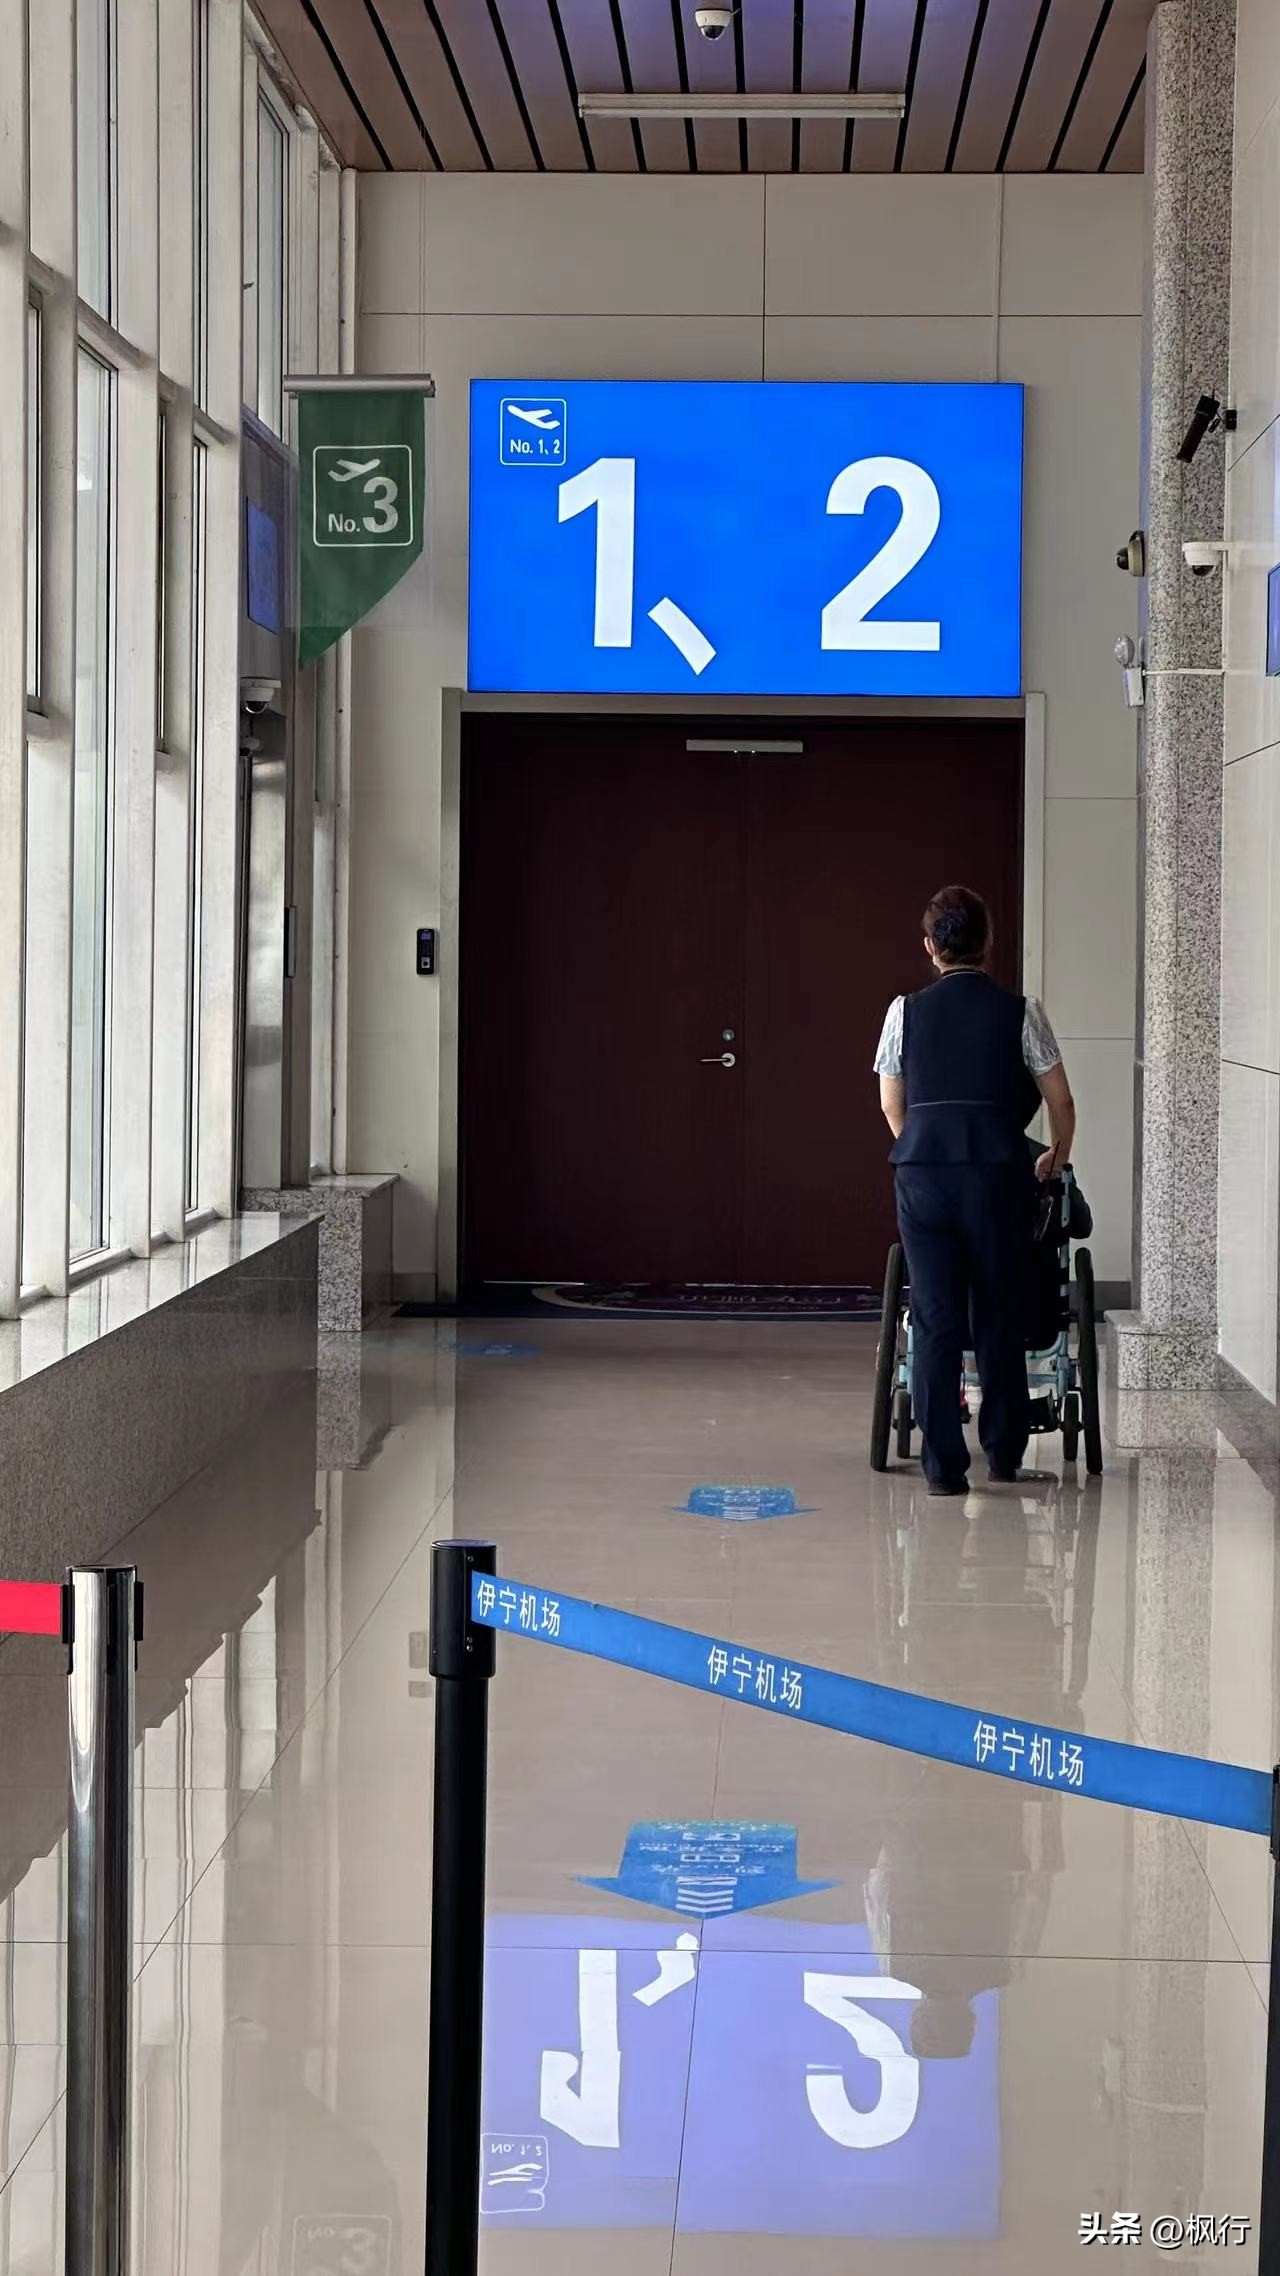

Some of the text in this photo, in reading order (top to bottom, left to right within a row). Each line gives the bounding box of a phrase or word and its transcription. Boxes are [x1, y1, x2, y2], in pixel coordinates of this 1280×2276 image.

[510, 438, 533, 454] No.
[477, 1579, 561, 1637] 伊宁机场
[707, 1644, 803, 1710] 伊宁机场
[973, 1719, 1085, 1787] 伊宁机场
